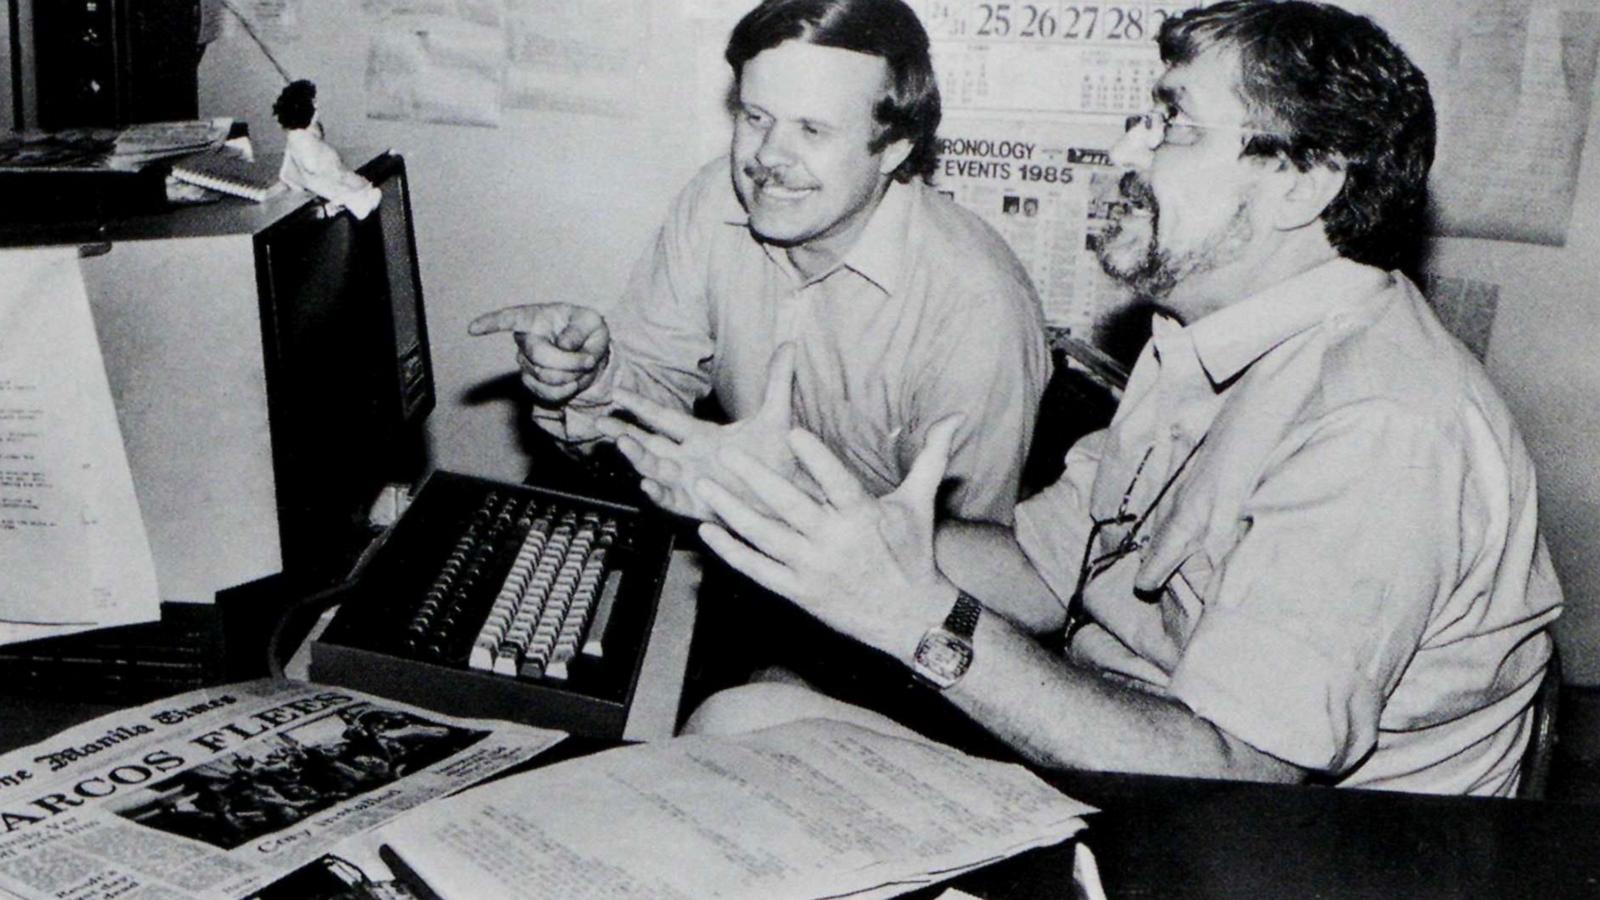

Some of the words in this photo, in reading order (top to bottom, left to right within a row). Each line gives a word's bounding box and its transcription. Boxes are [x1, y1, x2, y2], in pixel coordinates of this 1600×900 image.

[976, 4, 1011, 36] 25
[1019, 5, 1056, 37] 26
[1063, 6, 1099, 39] 27
[1105, 7, 1144, 40] 28
[937, 137, 1036, 161] RONOLOGY
[944, 159, 1011, 180] EVENTS
[1018, 164, 1074, 184] 1985
[1, 749, 185, 833] ARCOS
[188, 692, 354, 754] FLEES
[34, 721, 154, 772] Manila
